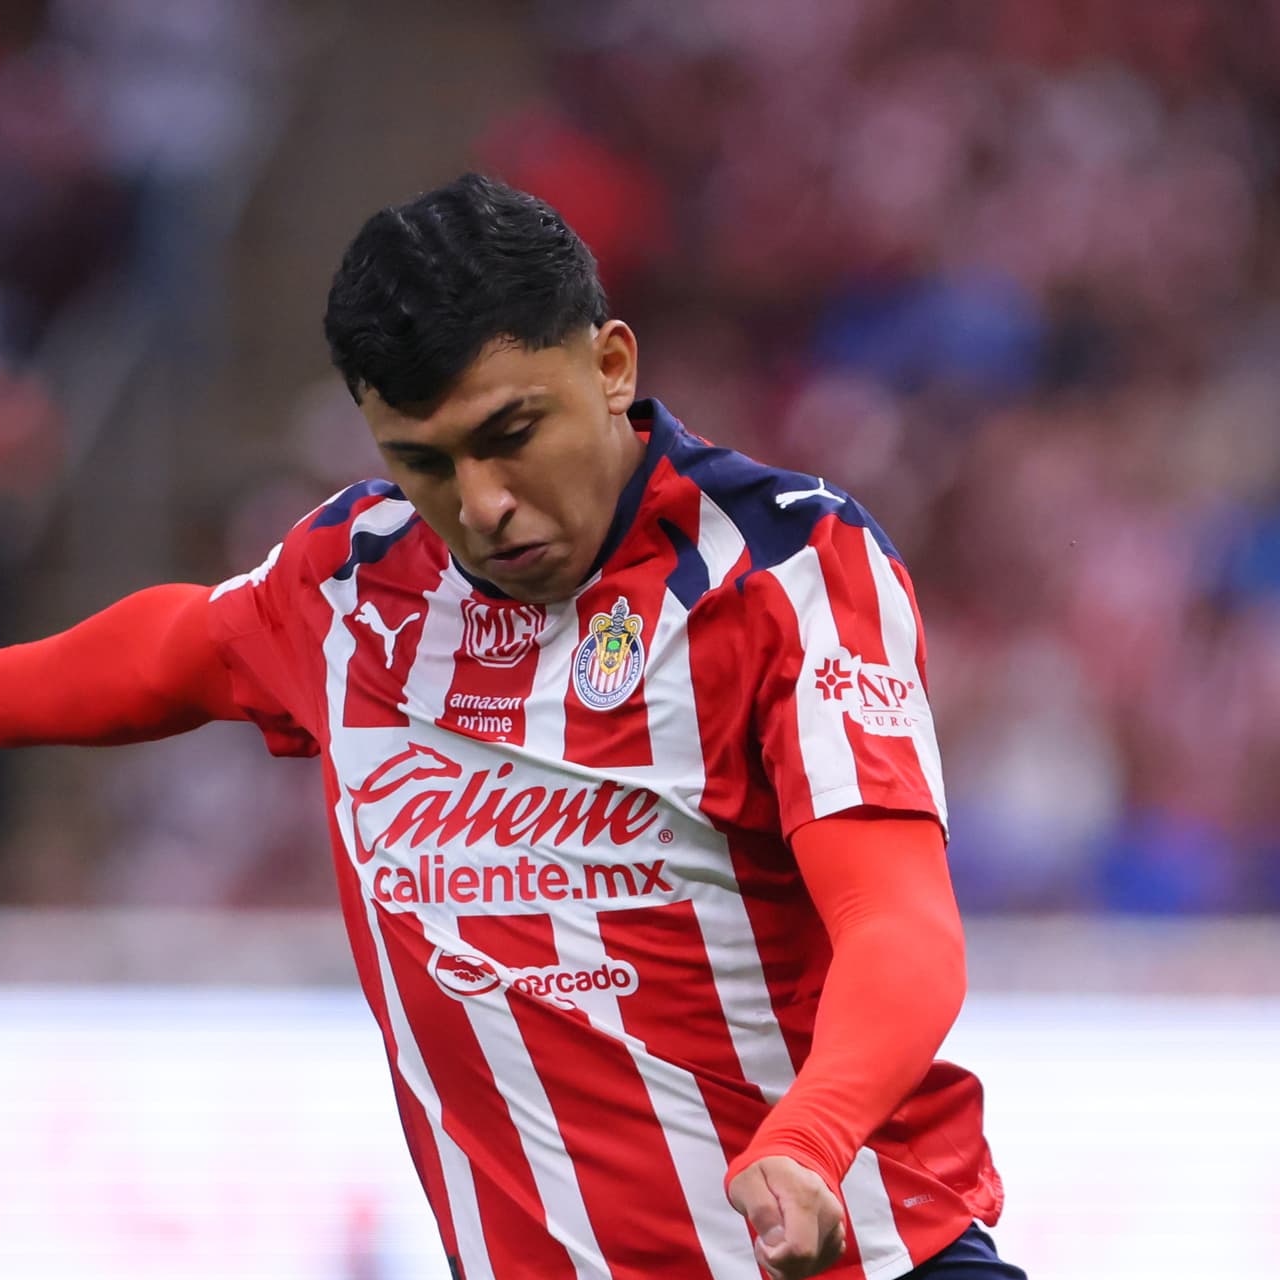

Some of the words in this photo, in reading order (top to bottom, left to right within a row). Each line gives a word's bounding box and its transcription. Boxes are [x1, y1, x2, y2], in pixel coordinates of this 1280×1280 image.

[579, 648, 591, 670] CLUB
[449, 692, 522, 711] amazon
[857, 668, 908, 709] NP
[346, 741, 660, 865] Caliente
[372, 854, 674, 905] caliente.mx
